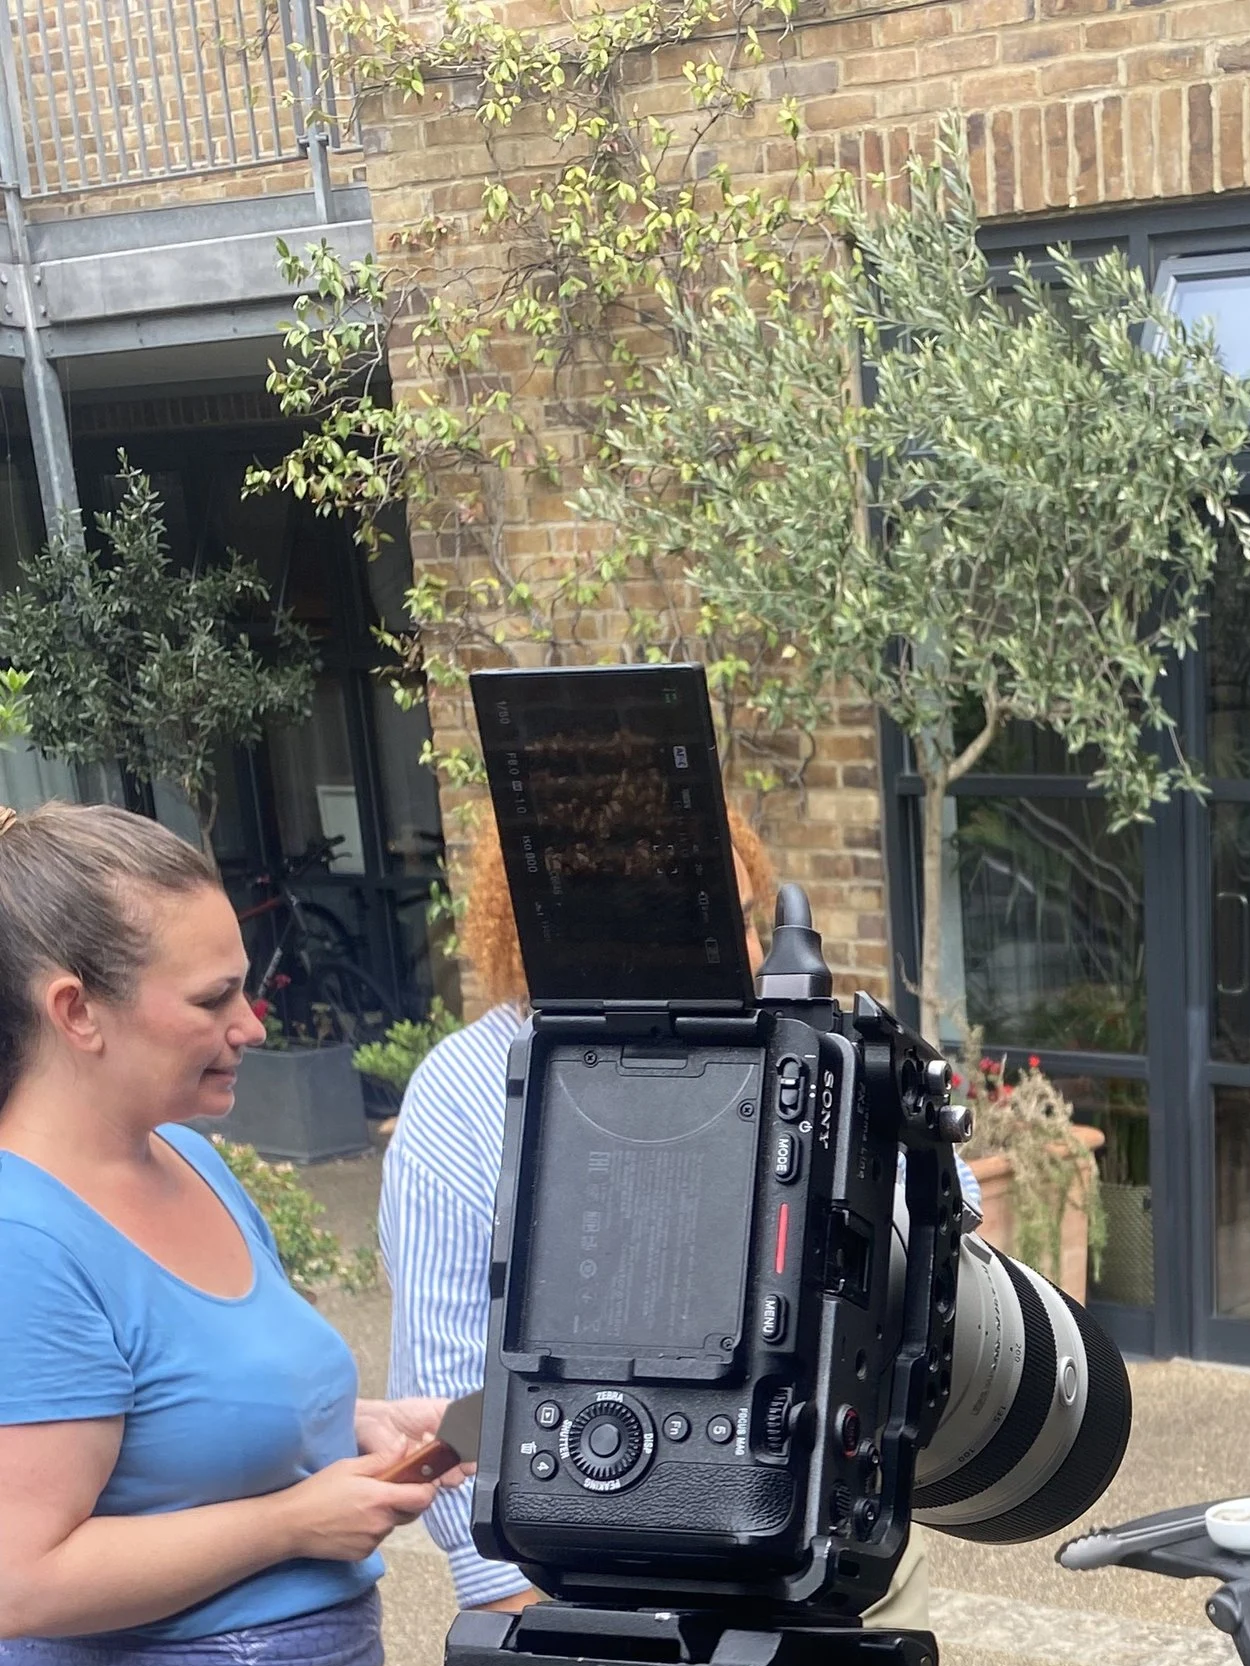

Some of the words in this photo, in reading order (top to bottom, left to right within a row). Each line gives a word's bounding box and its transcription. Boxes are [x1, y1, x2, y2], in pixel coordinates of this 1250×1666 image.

[818, 1069, 835, 1150] SONY
[776, 1138, 790, 1172] MODE
[762, 1297, 776, 1333] MENU
[1013, 1342, 1023, 1363] 200
[596, 1391, 624, 1402] ZEBRA
[669, 1420, 682, 1435] Fn
[735, 1407, 749, 1435] FOCUS
[558, 1418, 573, 1460] SHUTTER
[642, 1432, 654, 1455] DISP
[734, 1436, 747, 1456] MAG
[957, 1446, 976, 1463] 100
[583, 1478, 622, 1492] PEAKING
